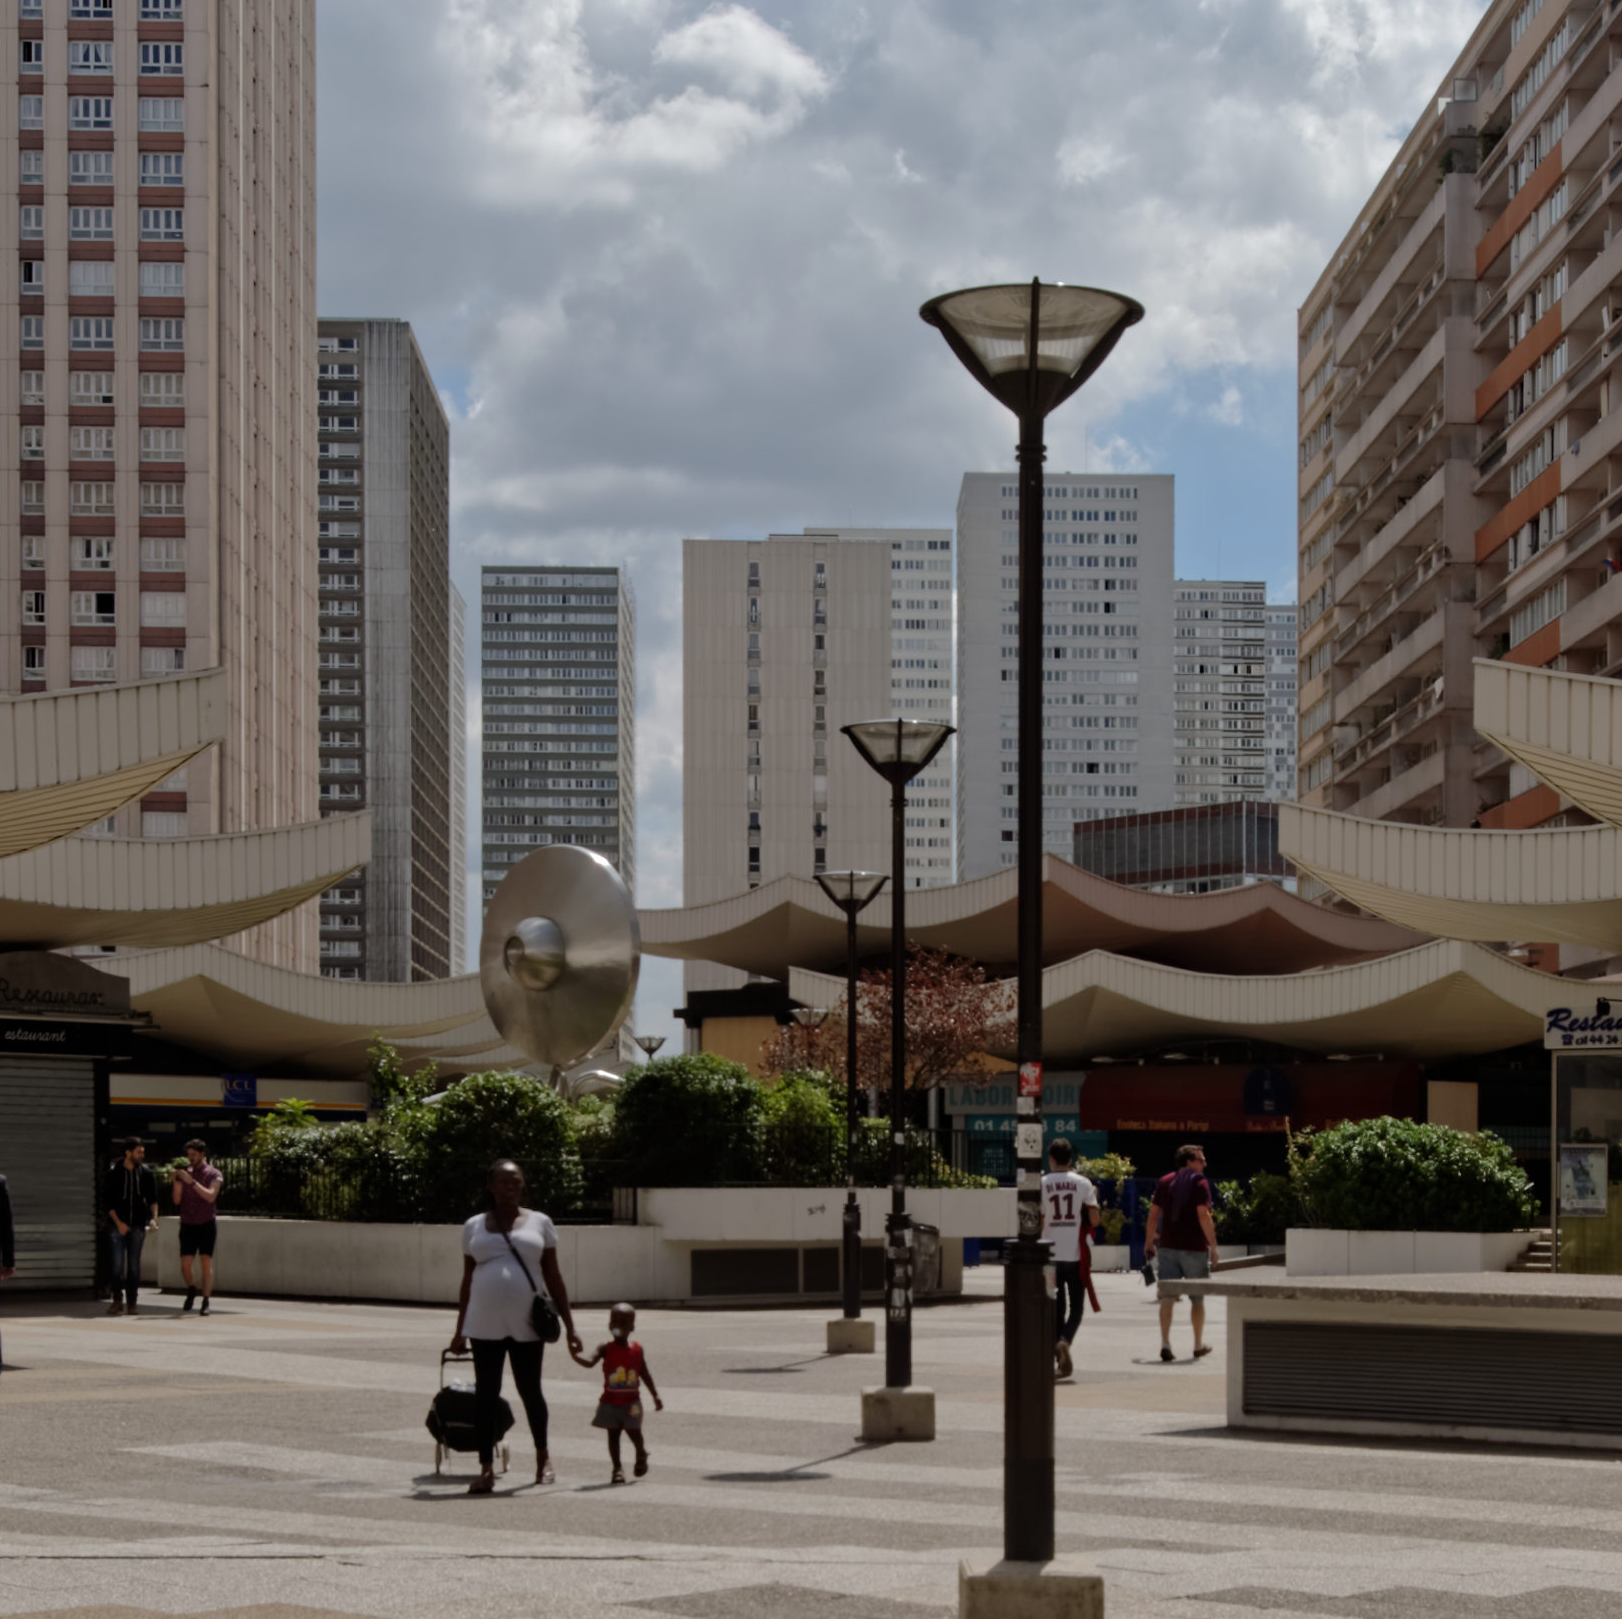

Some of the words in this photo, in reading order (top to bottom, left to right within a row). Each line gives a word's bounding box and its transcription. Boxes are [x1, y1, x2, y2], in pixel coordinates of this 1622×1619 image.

[225, 1079, 252, 1091] LCL
[949, 1084, 1082, 1106] LABOROIR
[1055, 1119, 1076, 1133] 84
[1049, 1193, 1075, 1220] 11
